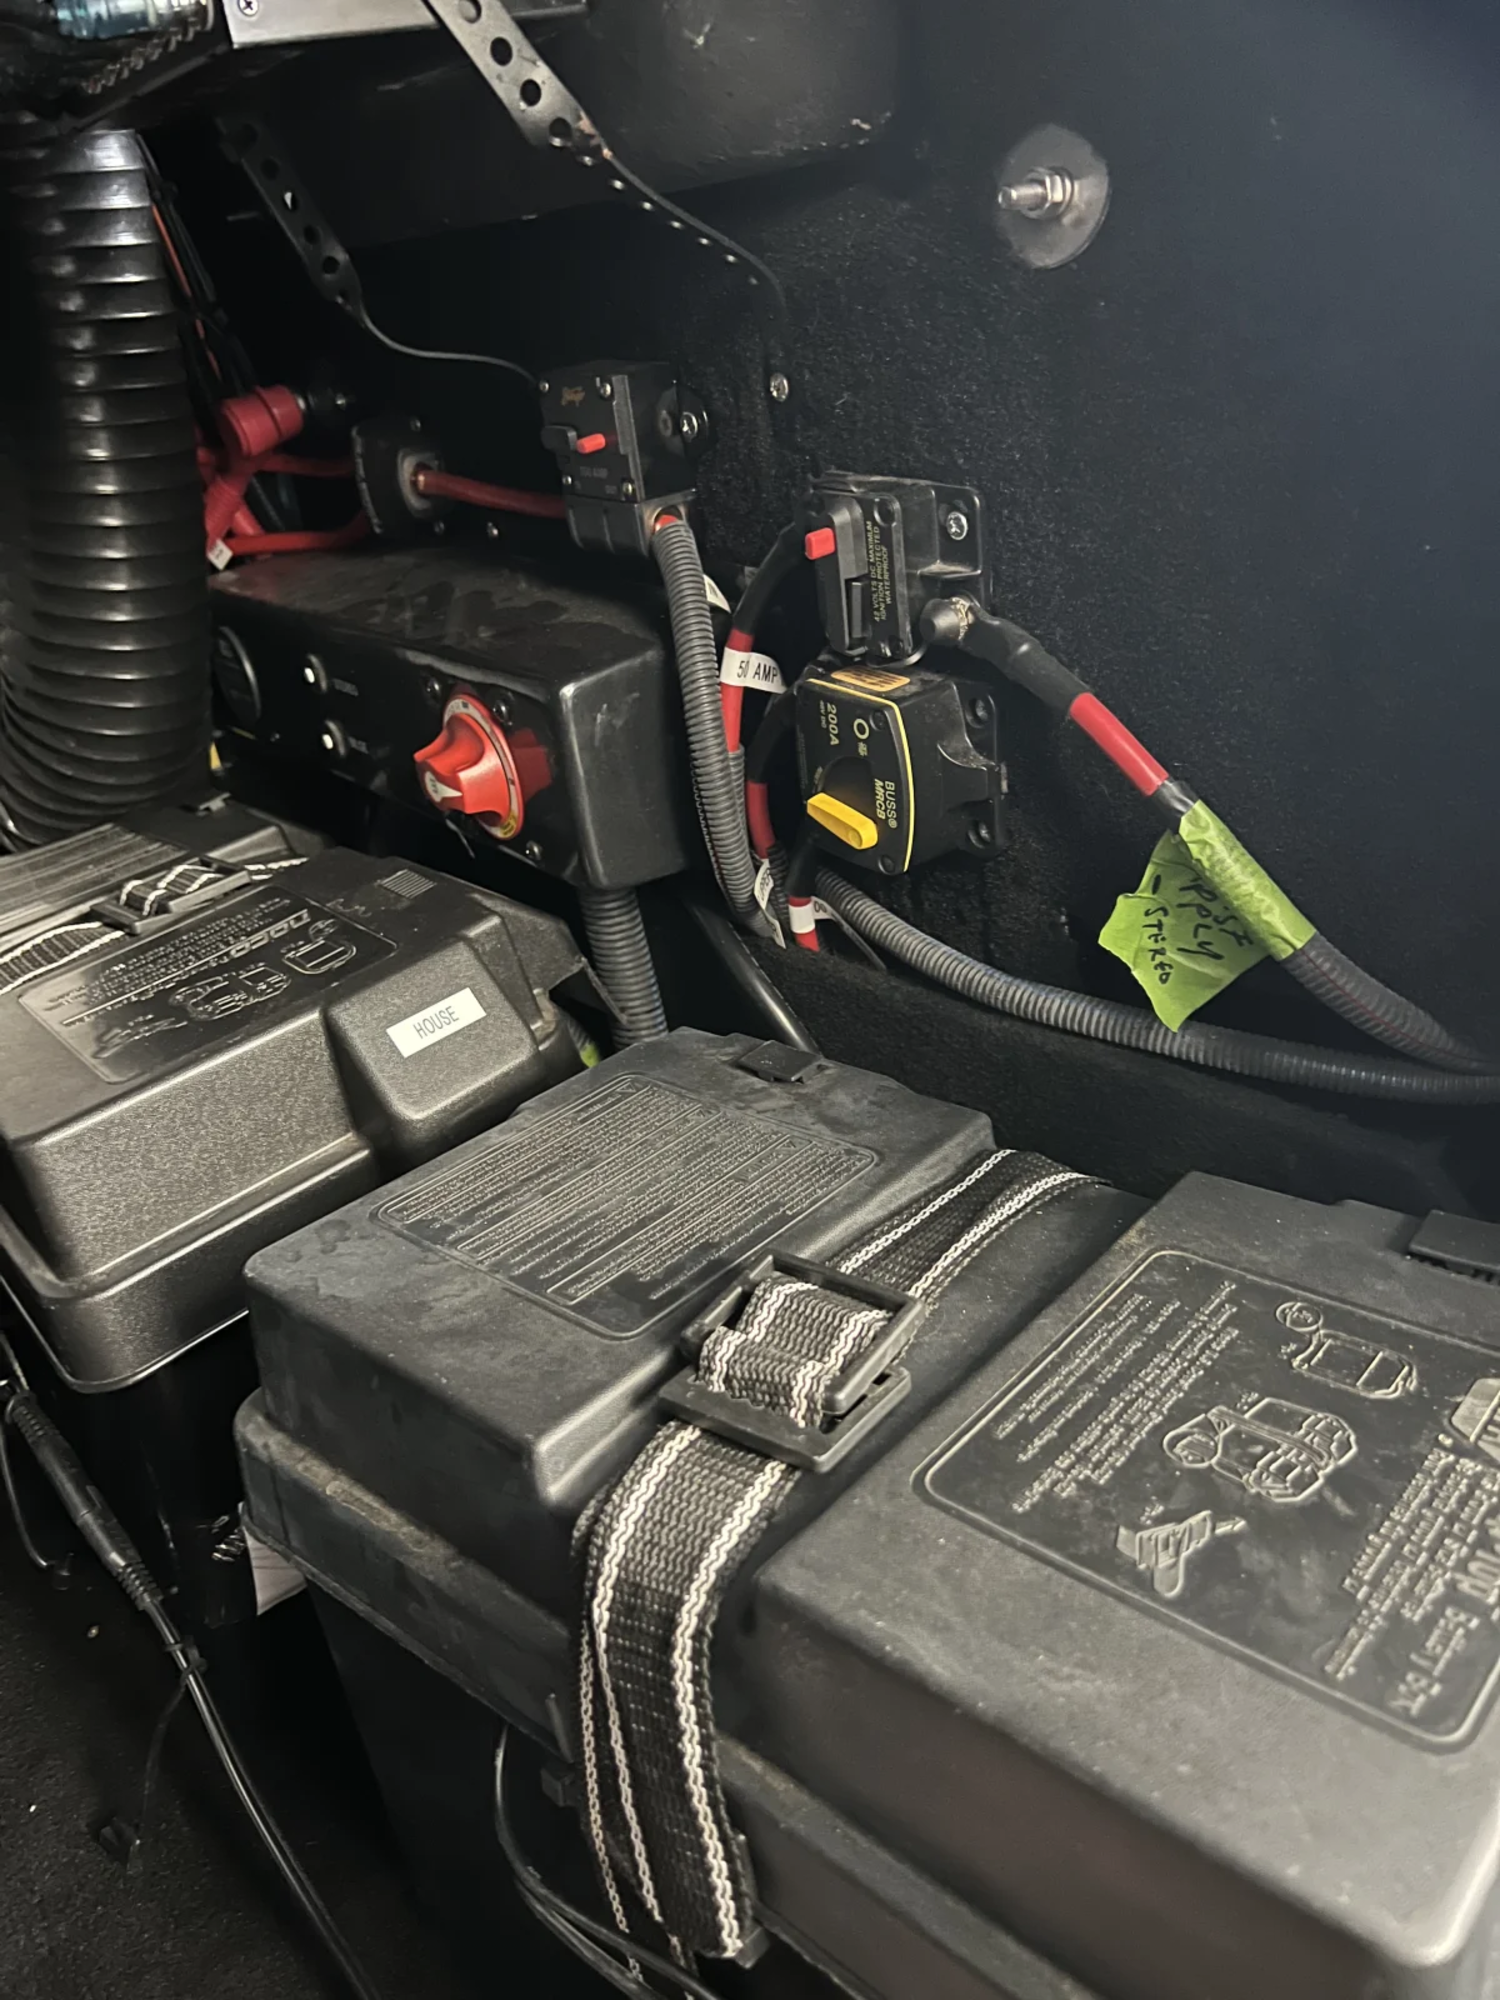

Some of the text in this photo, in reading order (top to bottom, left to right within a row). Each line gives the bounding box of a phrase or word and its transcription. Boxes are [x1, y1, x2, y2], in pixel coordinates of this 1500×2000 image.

[866, 520, 875, 562] MAXIMUM
[871, 580, 879, 607] VOLTS
[736, 660, 778, 684] 50 AMP
[827, 703, 840, 746] 200A
[874, 778, 886, 820] MRCB
[413, 1005, 460, 1040] HOUSE
